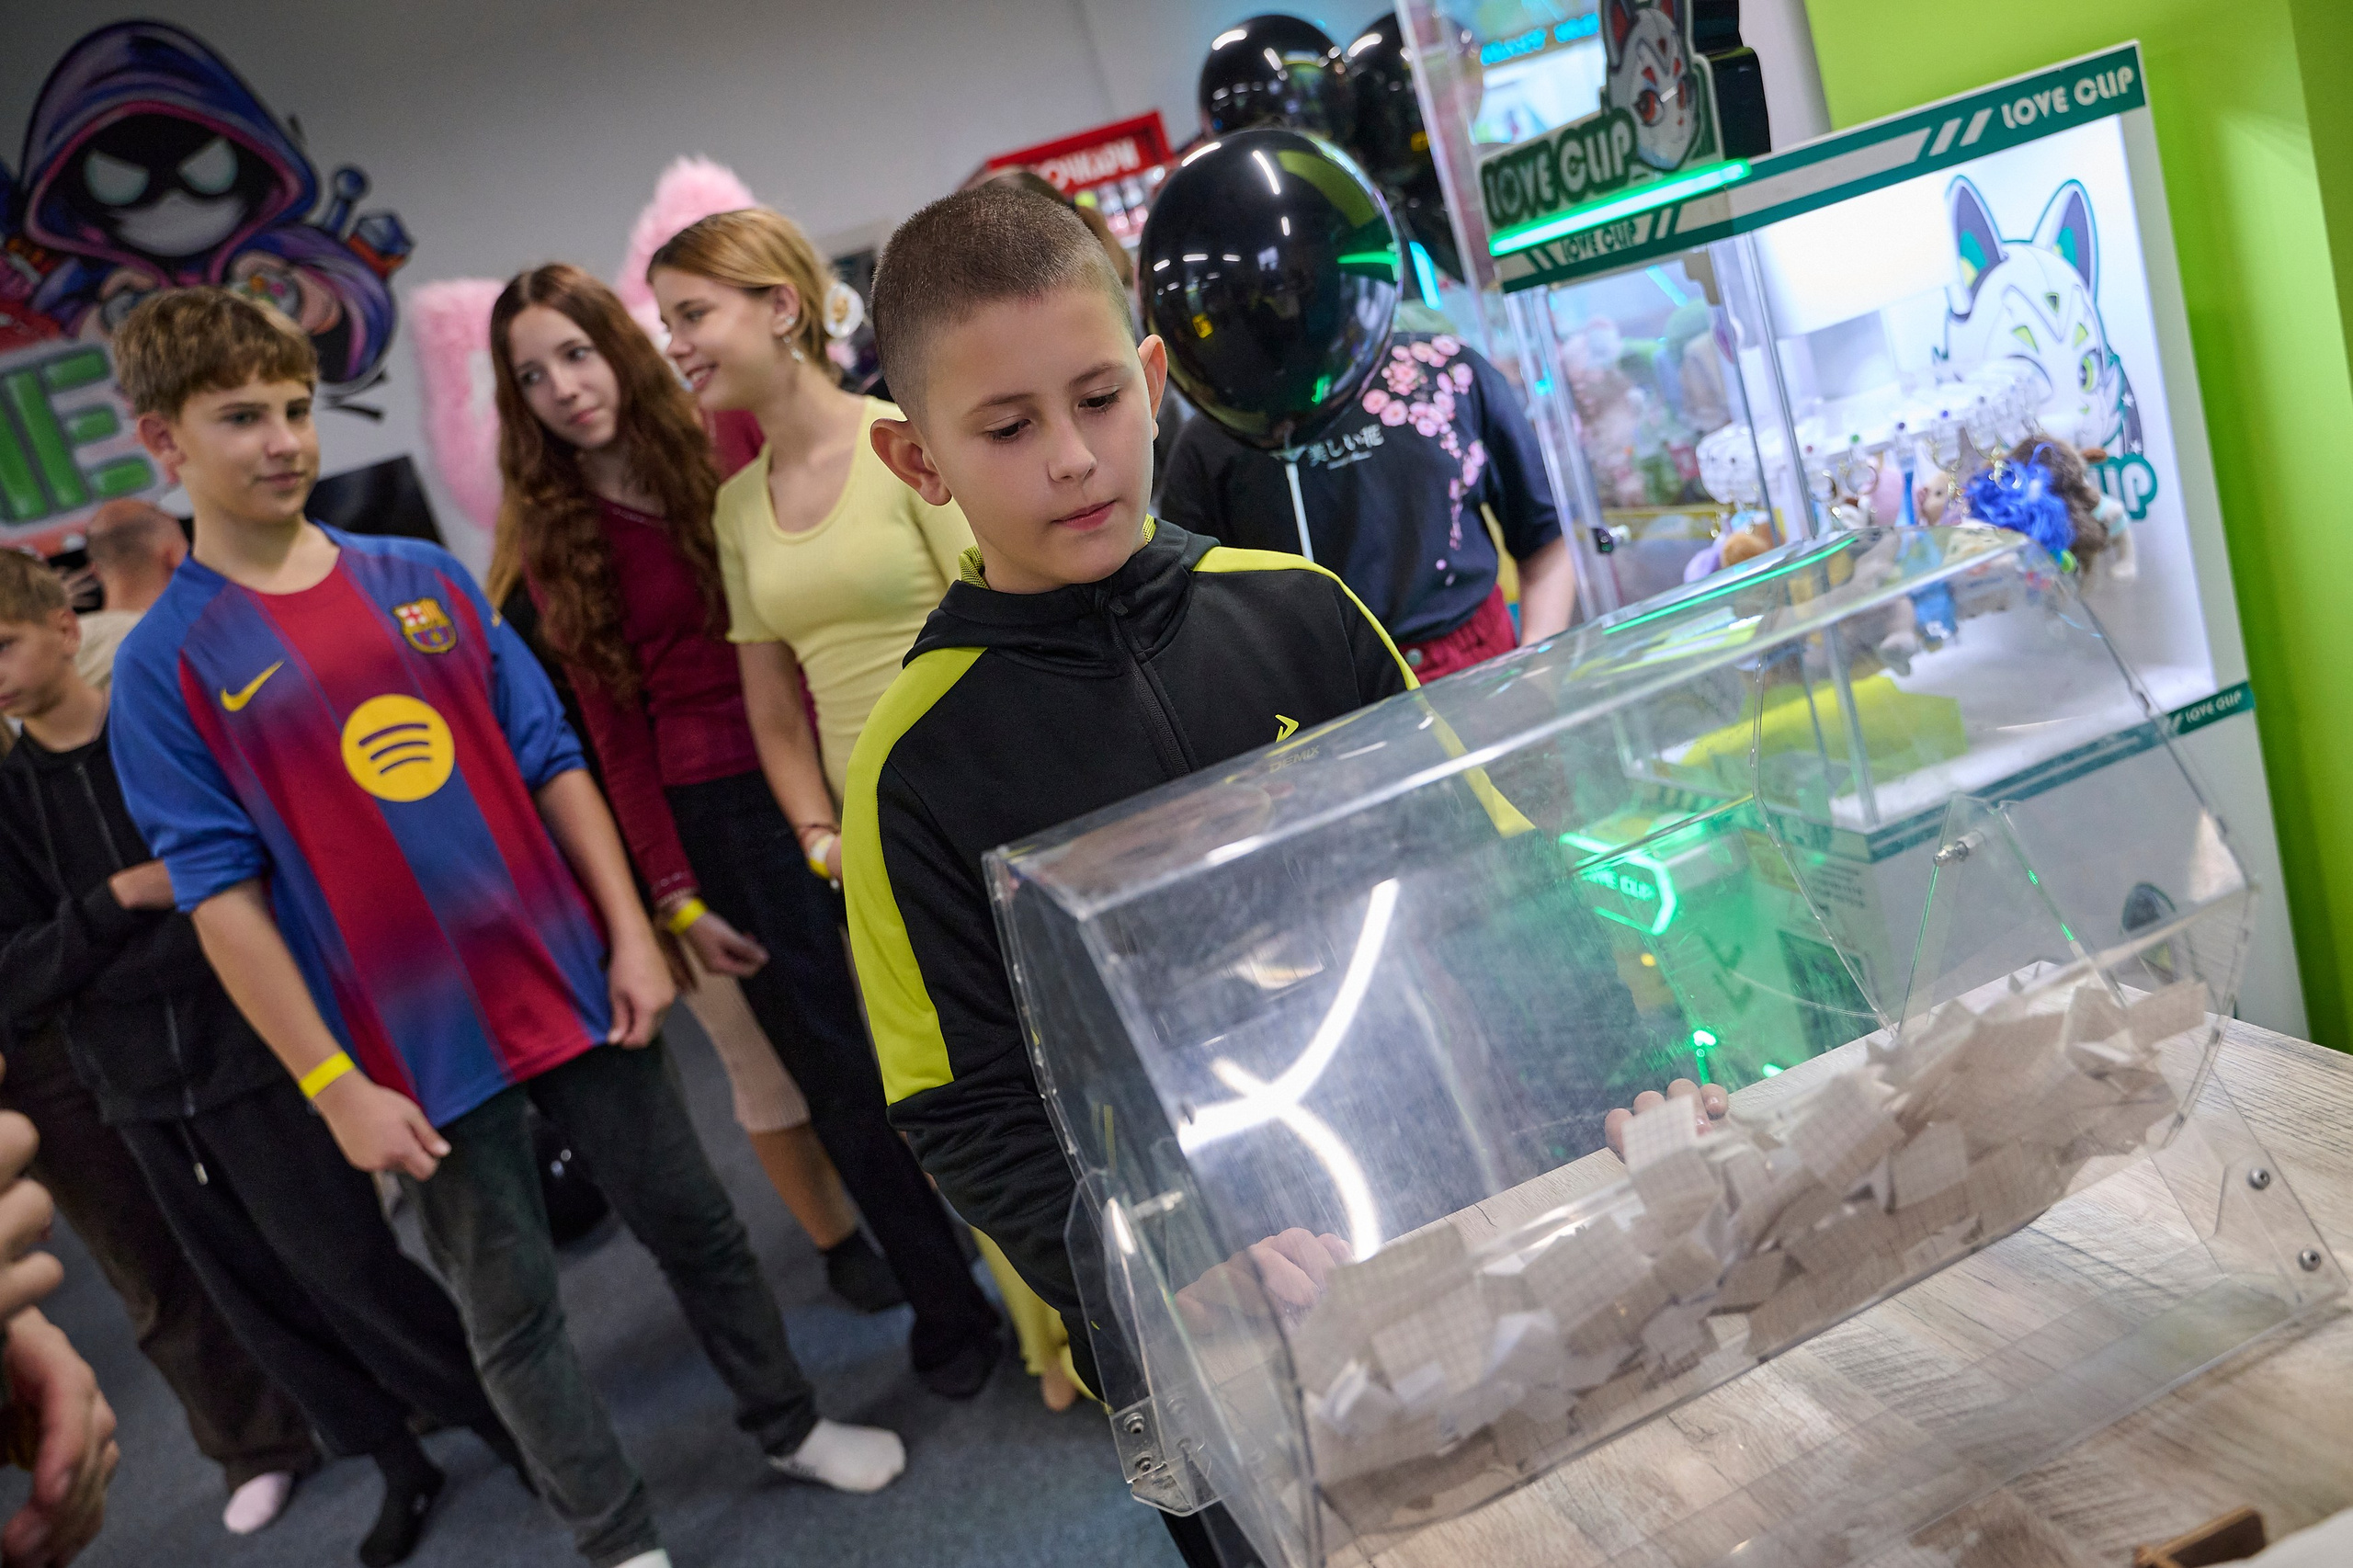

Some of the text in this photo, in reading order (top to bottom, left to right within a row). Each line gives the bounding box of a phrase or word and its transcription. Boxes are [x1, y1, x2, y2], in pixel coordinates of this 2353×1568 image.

[2001, 65, 2134, 129] LOVE CLIP
[1483, 142, 1557, 223] LOVE
[1269, 744, 1320, 773] DEMIX
